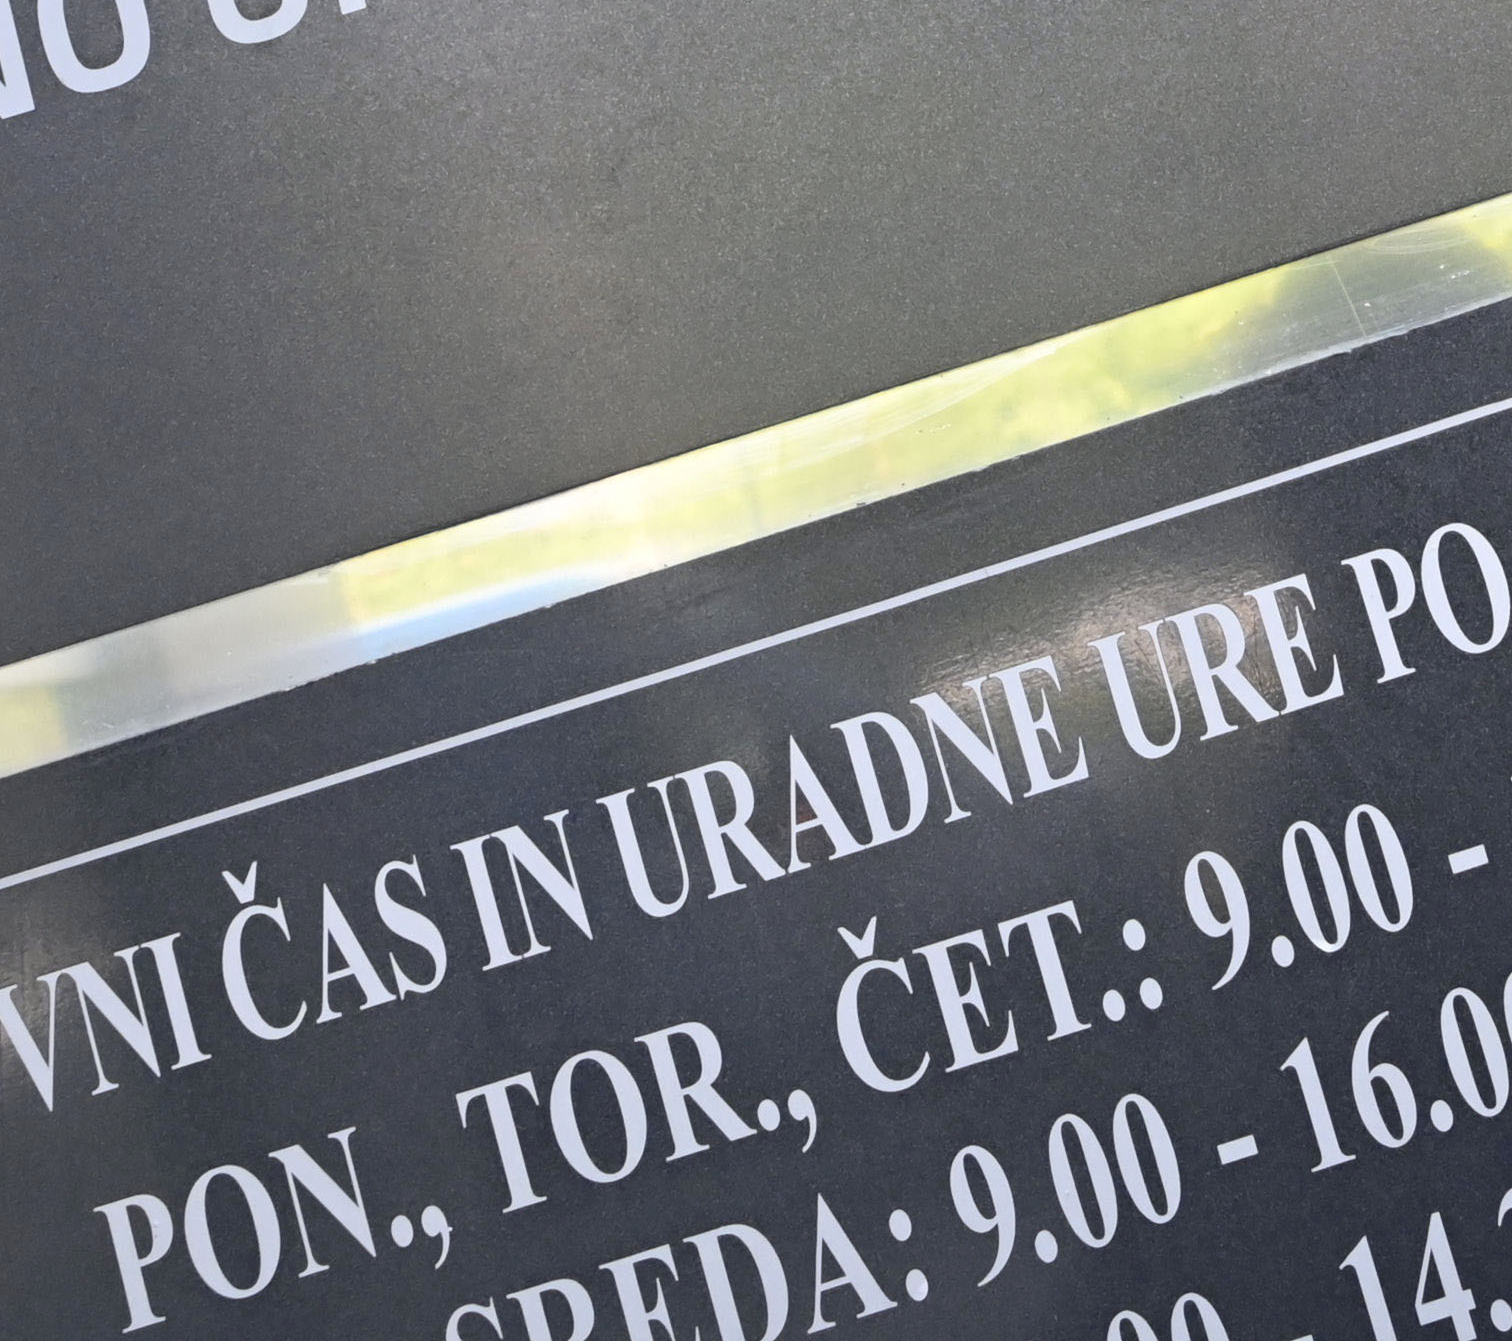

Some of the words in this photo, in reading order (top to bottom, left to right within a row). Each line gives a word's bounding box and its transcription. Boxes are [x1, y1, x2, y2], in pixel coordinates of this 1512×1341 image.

[220, 859, 449, 1041] ČAS
[449, 808, 594, 972] IN
[594, 653, 1090, 919] URADNE
[1086, 572, 1346, 760] URE
[1339, 521, 1512, 685] PO
[92, 1124, 455, 1335] PON.,
[453, 1020, 818, 1216] TOR.,
[835, 899, 1164, 1094] ČET.:
[1183, 802, 1415, 992] 9.00
[1446, 843, 1490, 876] -
[948, 1091, 1182, 1288] 9.00
[1215, 1133, 1260, 1166] -
